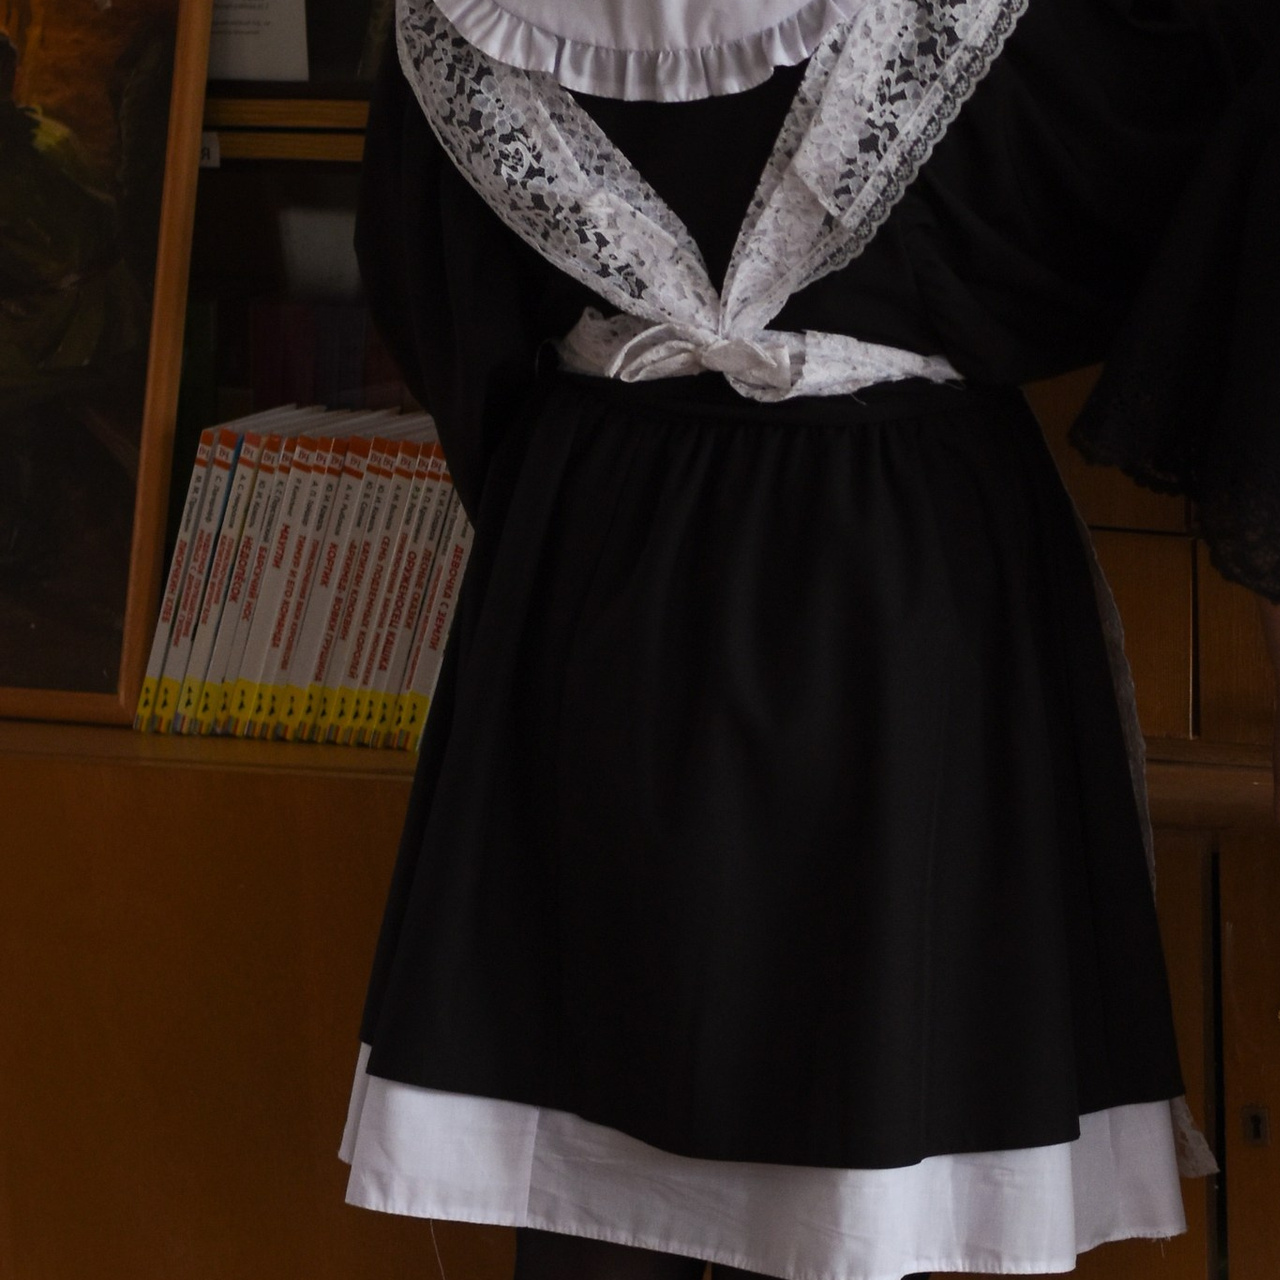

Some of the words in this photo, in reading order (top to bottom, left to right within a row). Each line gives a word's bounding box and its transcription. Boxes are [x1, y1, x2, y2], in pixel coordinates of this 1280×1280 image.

[166, 539, 189, 594] ЛИСИЧКИН
[271, 523, 291, 569] МАУГЛИ
[291, 534, 307, 569] ТИМУР
[319, 542, 339, 588] КОРТИК
[352, 541, 372, 588] КАПИТАН
[376, 535, 391, 563] СЕМЬ
[228, 535, 257, 604] НЕДОПЁСОК
[246, 546, 270, 600] БАРСУЧИЙ
[284, 579, 295, 598] ЕГО
[388, 550, 418, 629] ОРУЖЕНОСЕЦ
[415, 549, 432, 590] ЛЕСНЫЕ
[441, 545, 465, 599] ДЕВОЧКА
[161, 597, 175, 623] ХЛЕБ
[241, 601, 254, 621] НОС
[327, 596, 343, 631] ВОВКИ
[338, 589, 359, 641] КЛЮКВИН
[360, 563, 384, 628] ПОДЗЕМНЫХ
[404, 591, 421, 630] СКАЗКИ
[270, 599, 291, 648] КОМАНДА
[428, 610, 447, 651] ЗЕМЛИ
[313, 633, 334, 682] ГРУШИНА
[347, 630, 369, 679] КОРОЛЕЙ
[377, 630, 396, 672] КАШКА
